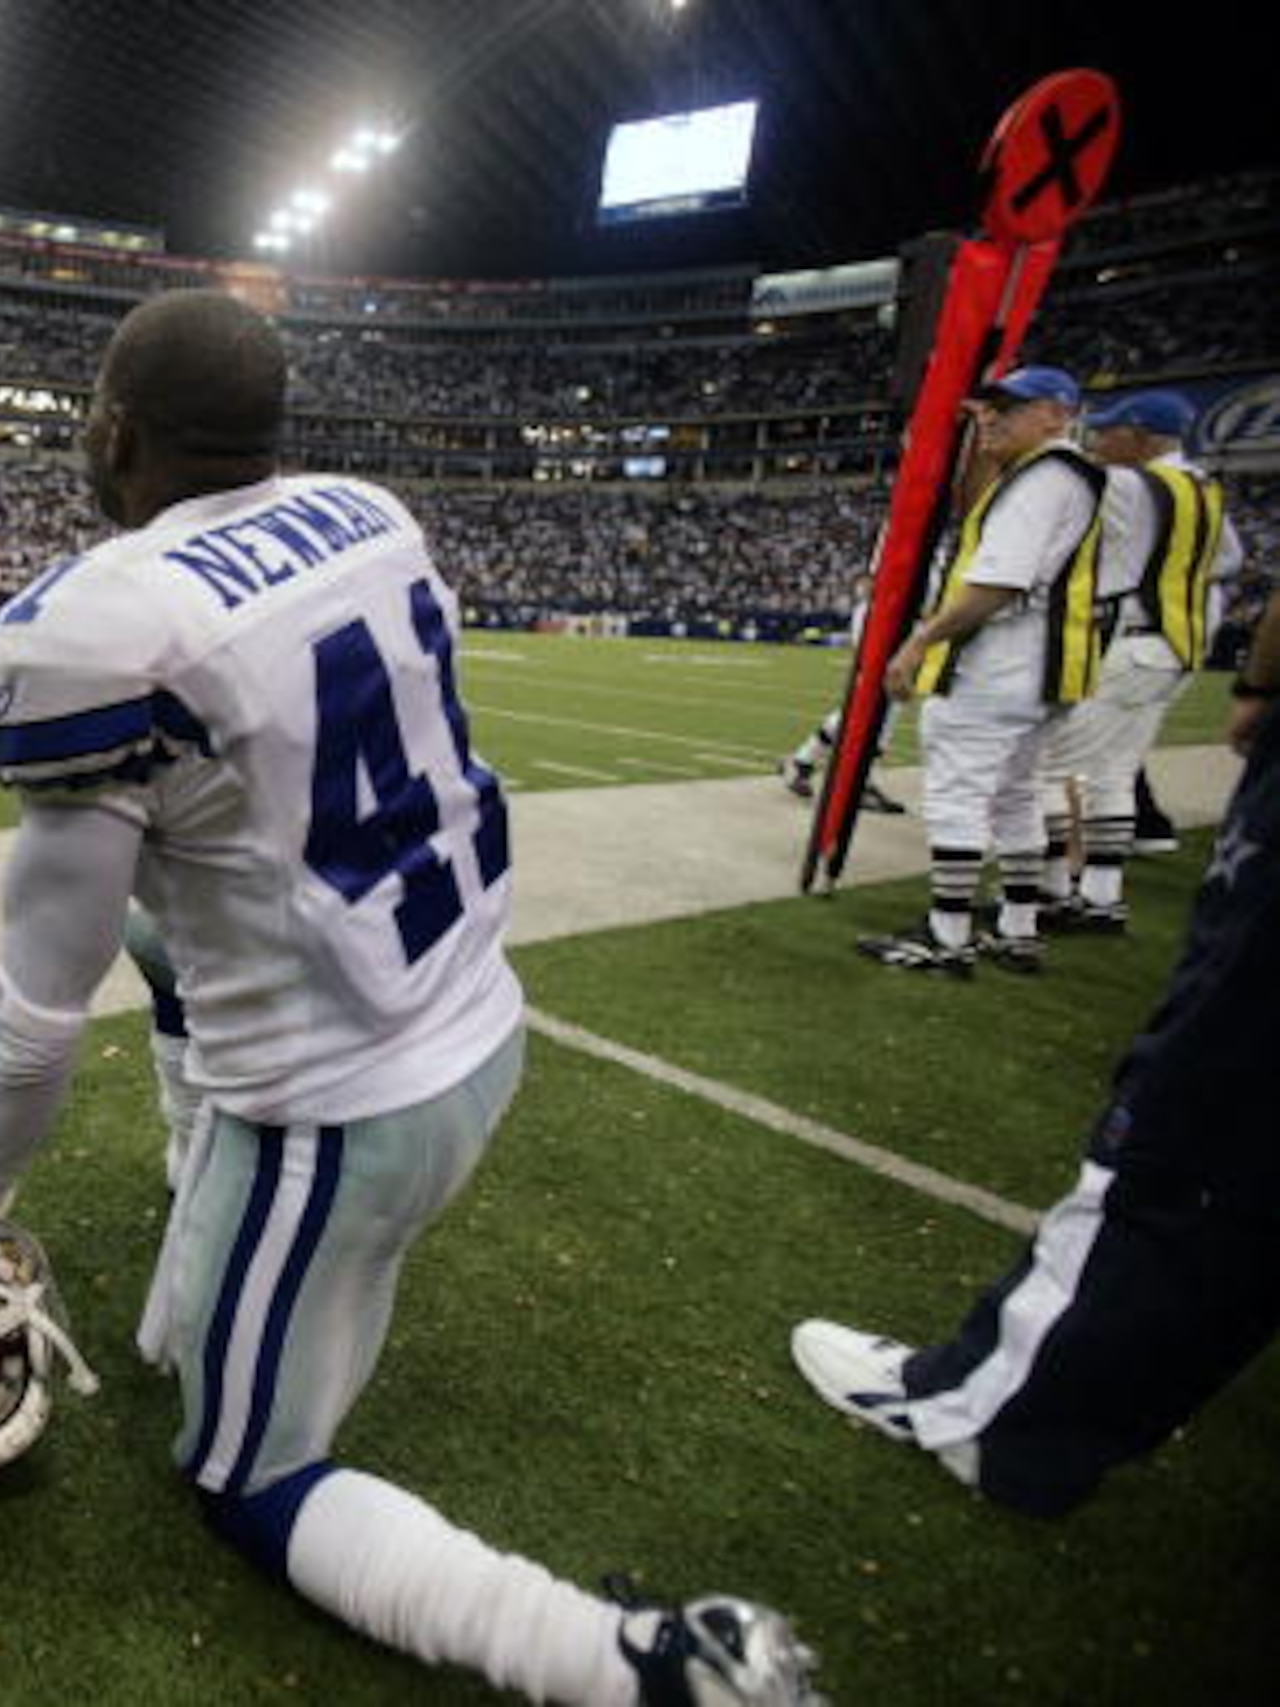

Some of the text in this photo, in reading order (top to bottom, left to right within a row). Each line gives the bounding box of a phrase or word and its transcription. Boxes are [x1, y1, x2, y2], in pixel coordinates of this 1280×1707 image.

[1010, 102, 1110, 215] X
[162, 487, 402, 608] NEWMAN
[303, 577, 511, 967] 41
